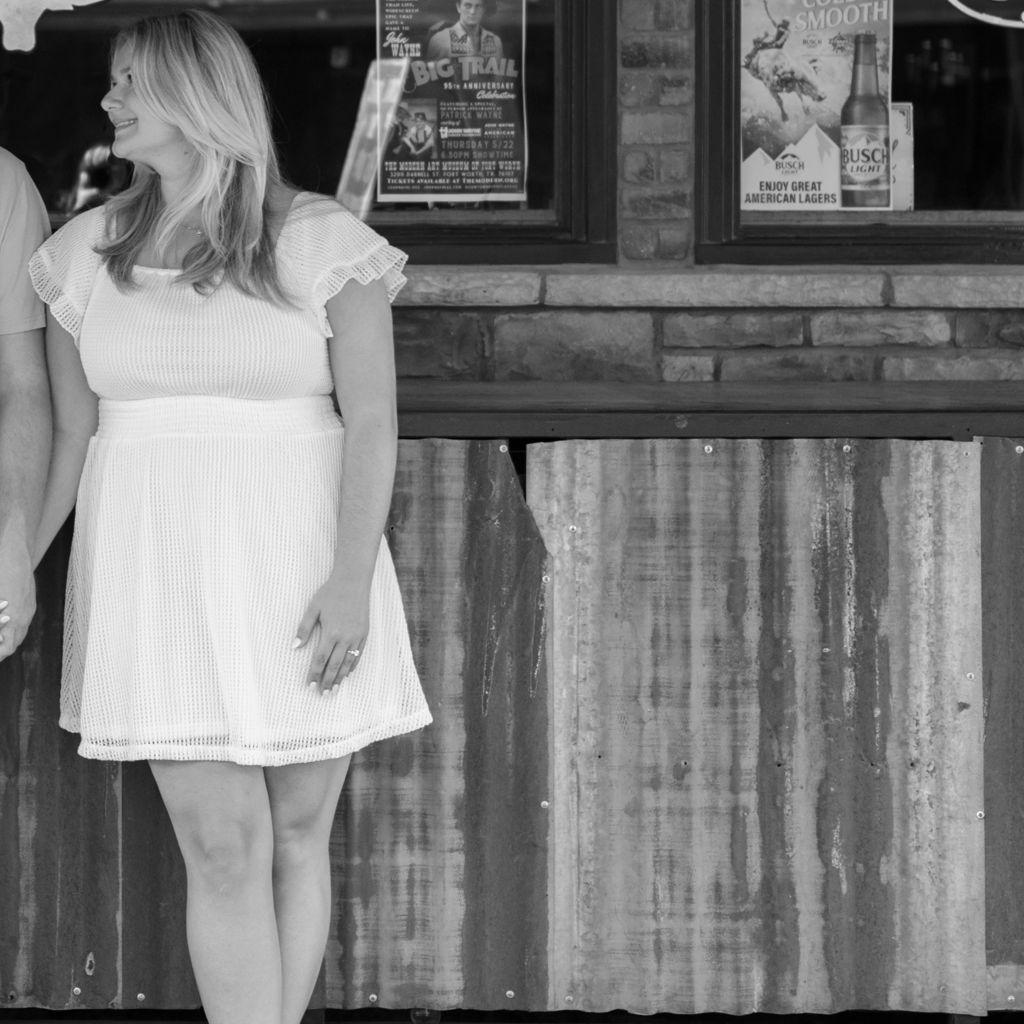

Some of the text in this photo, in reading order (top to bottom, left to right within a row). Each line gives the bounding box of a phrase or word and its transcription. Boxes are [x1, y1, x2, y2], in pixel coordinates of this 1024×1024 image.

[795, 1, 888, 32] SMOOTH
[382, 31, 409, 47] John
[391, 43, 421, 57] WAYNE
[411, 56, 519, 86] BIG TRAIL
[462, 81, 514, 90] ANNIVERSARY
[440, 111, 503, 119] PATRICK WAYNE
[442, 140, 514, 149] THURSDAY 5/22
[842, 148, 889, 165] BUSCH
[428, 161, 440, 171] ART
[442, 161, 469, 171] MUSEUM
[471, 161, 479, 171] OF
[775, 160, 805, 170] BUSCH
[850, 164, 882, 173] LIGHT
[759, 181, 822, 191] ENJOY GREAT
[744, 193, 837, 204] AMERICAN LAGERS
